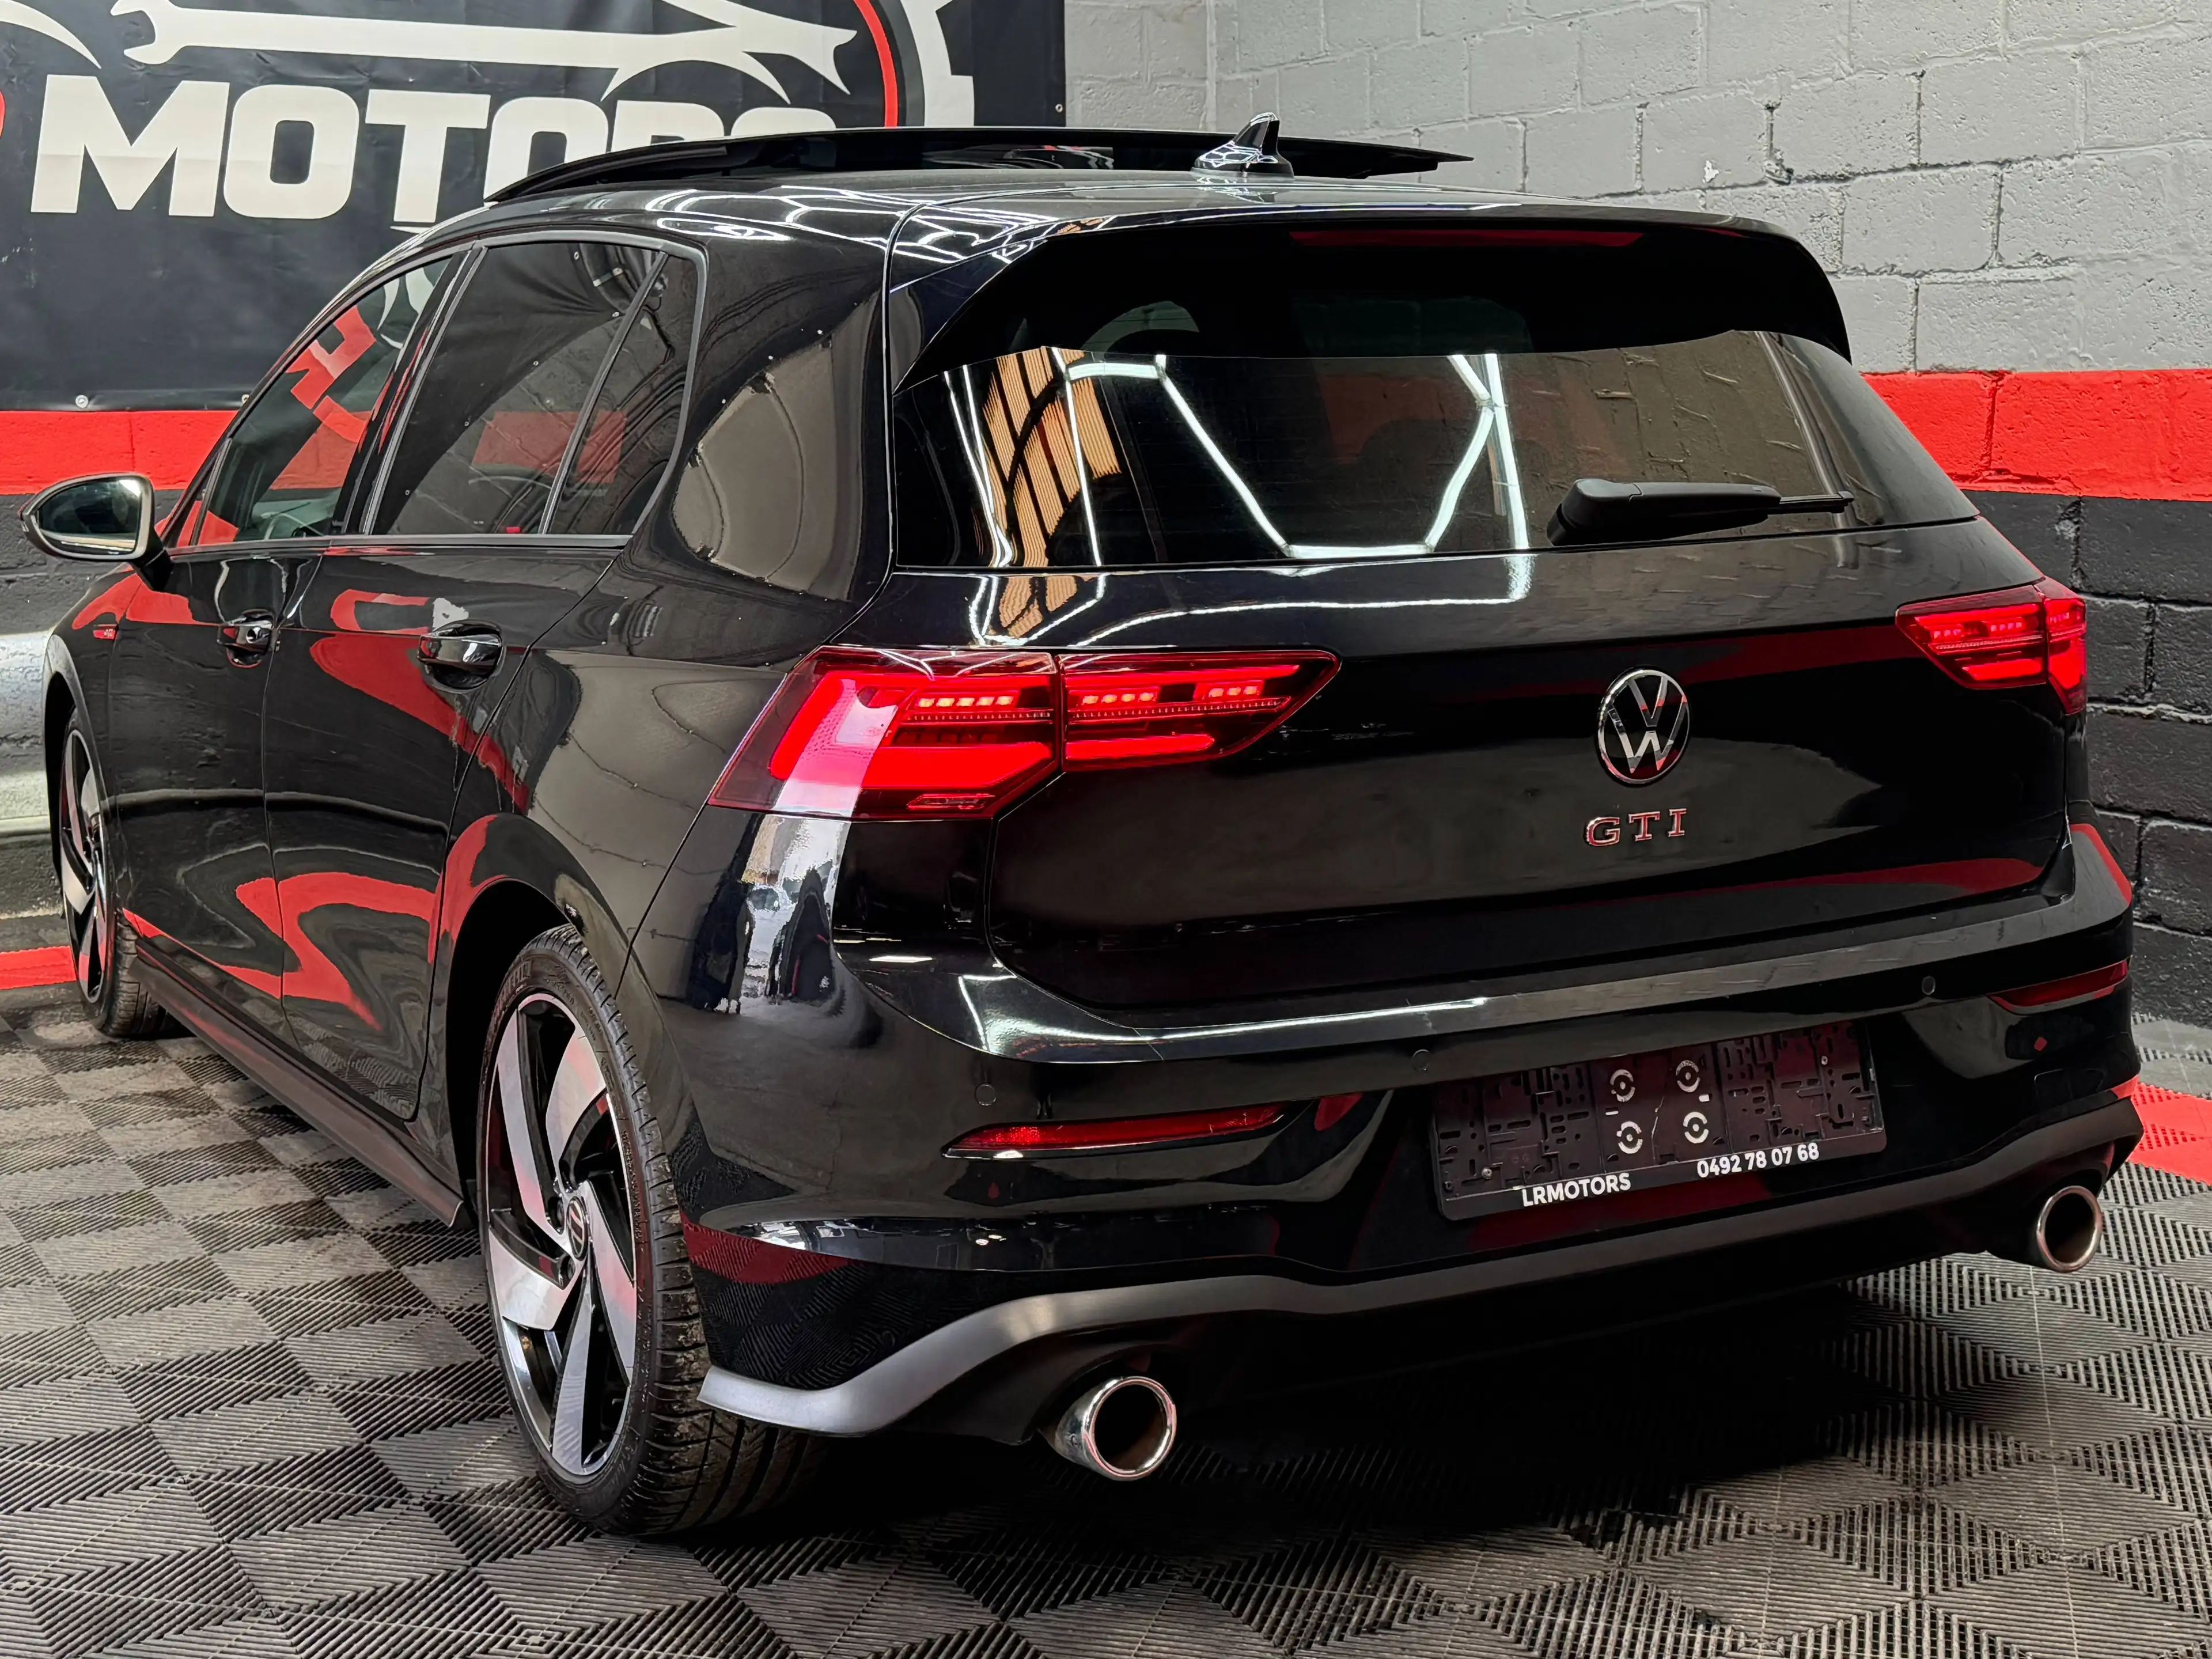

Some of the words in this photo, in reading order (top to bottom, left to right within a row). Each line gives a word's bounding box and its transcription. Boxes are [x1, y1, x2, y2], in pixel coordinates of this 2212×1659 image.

[31, 73, 838, 223] MOTO
[1599, 668, 1690, 782] VW
[1586, 808, 1687, 847] GTI
[1696, 1154, 1742, 1179] 0492
[1744, 1150, 1767, 1171] 78
[1771, 1146, 1793, 1166] 07
[1797, 1142, 1820, 1162] 68
[1521, 1172, 1631, 1207] LRMOTORS
